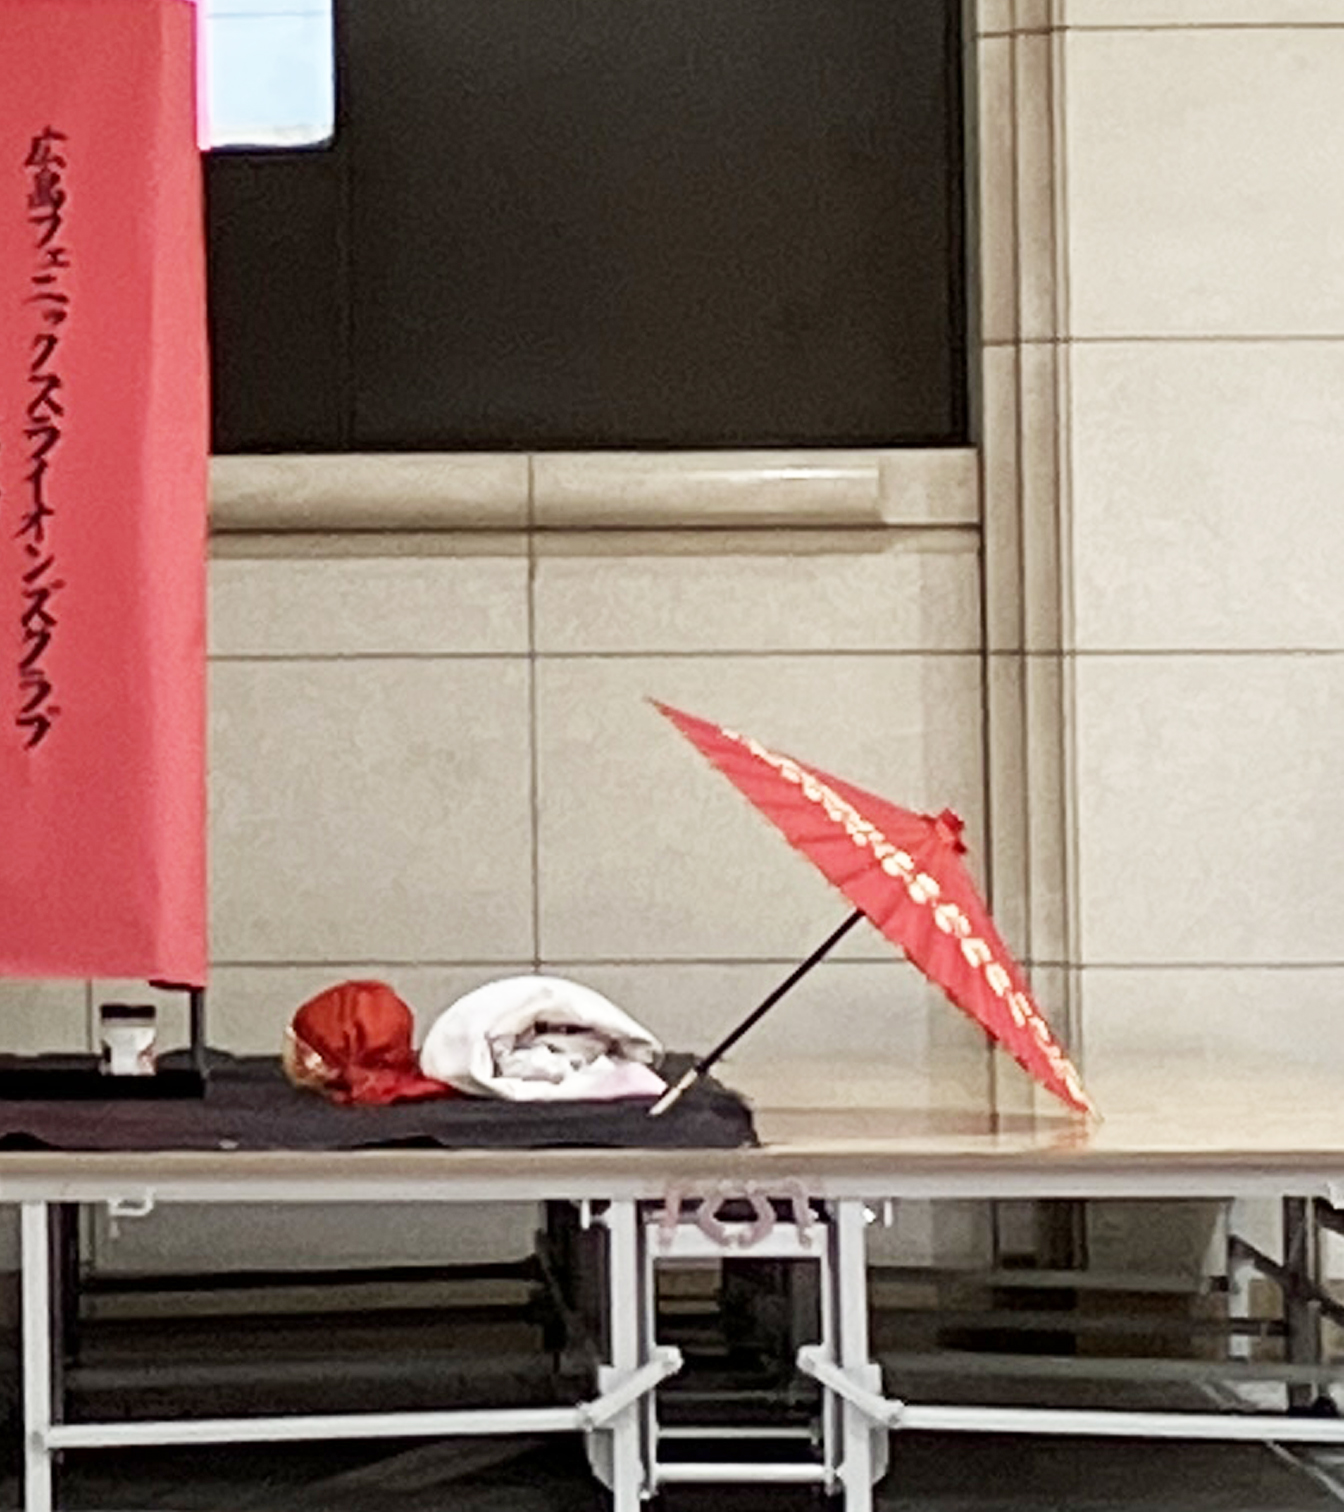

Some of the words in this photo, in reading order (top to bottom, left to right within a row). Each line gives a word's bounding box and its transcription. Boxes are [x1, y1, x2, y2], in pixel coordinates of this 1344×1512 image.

[13, 125, 71, 751] 広島フェニックスライオンズクラブ
